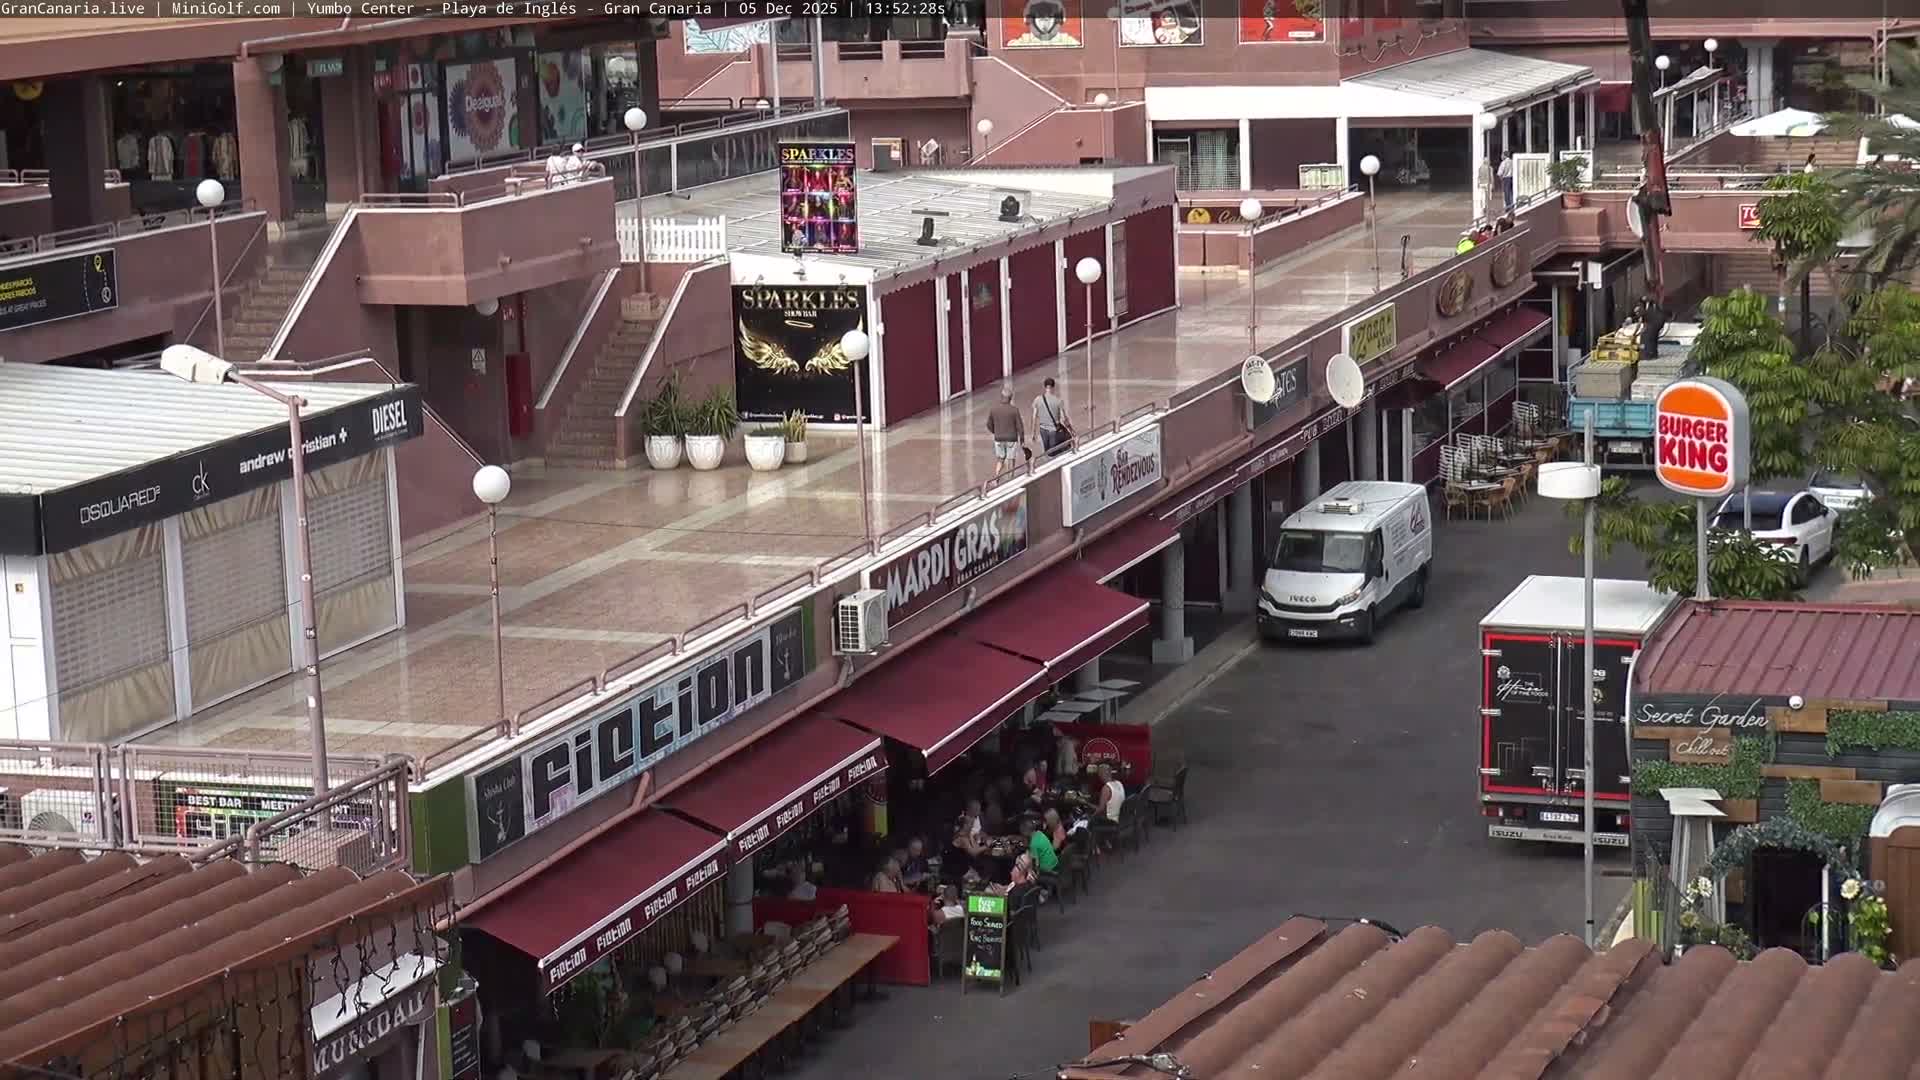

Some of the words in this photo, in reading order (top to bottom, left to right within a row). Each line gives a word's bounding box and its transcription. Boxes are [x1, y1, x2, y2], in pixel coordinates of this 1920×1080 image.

[782, 148, 854, 160] SPARKLES
[742, 290, 859, 309] SPARKLES
[373, 400, 407, 434] DIESEL
[1658, 414, 1728, 443] BURGER
[239, 451, 286, 474] andrew
[288, 434, 337, 459] cristian
[1658, 436, 1728, 473] KING
[886, 537, 950, 611] MARDI
[954, 510, 1000, 571] GRAS
[1289, 595, 1316, 603] IVECO
[1637, 703, 1694, 724] Secret
[1700, 690, 1768, 734] Garden
[188, 795, 219, 806] BEST
[220, 797, 242, 808] BAR
[1491, 830, 1523, 838] ISUZU
